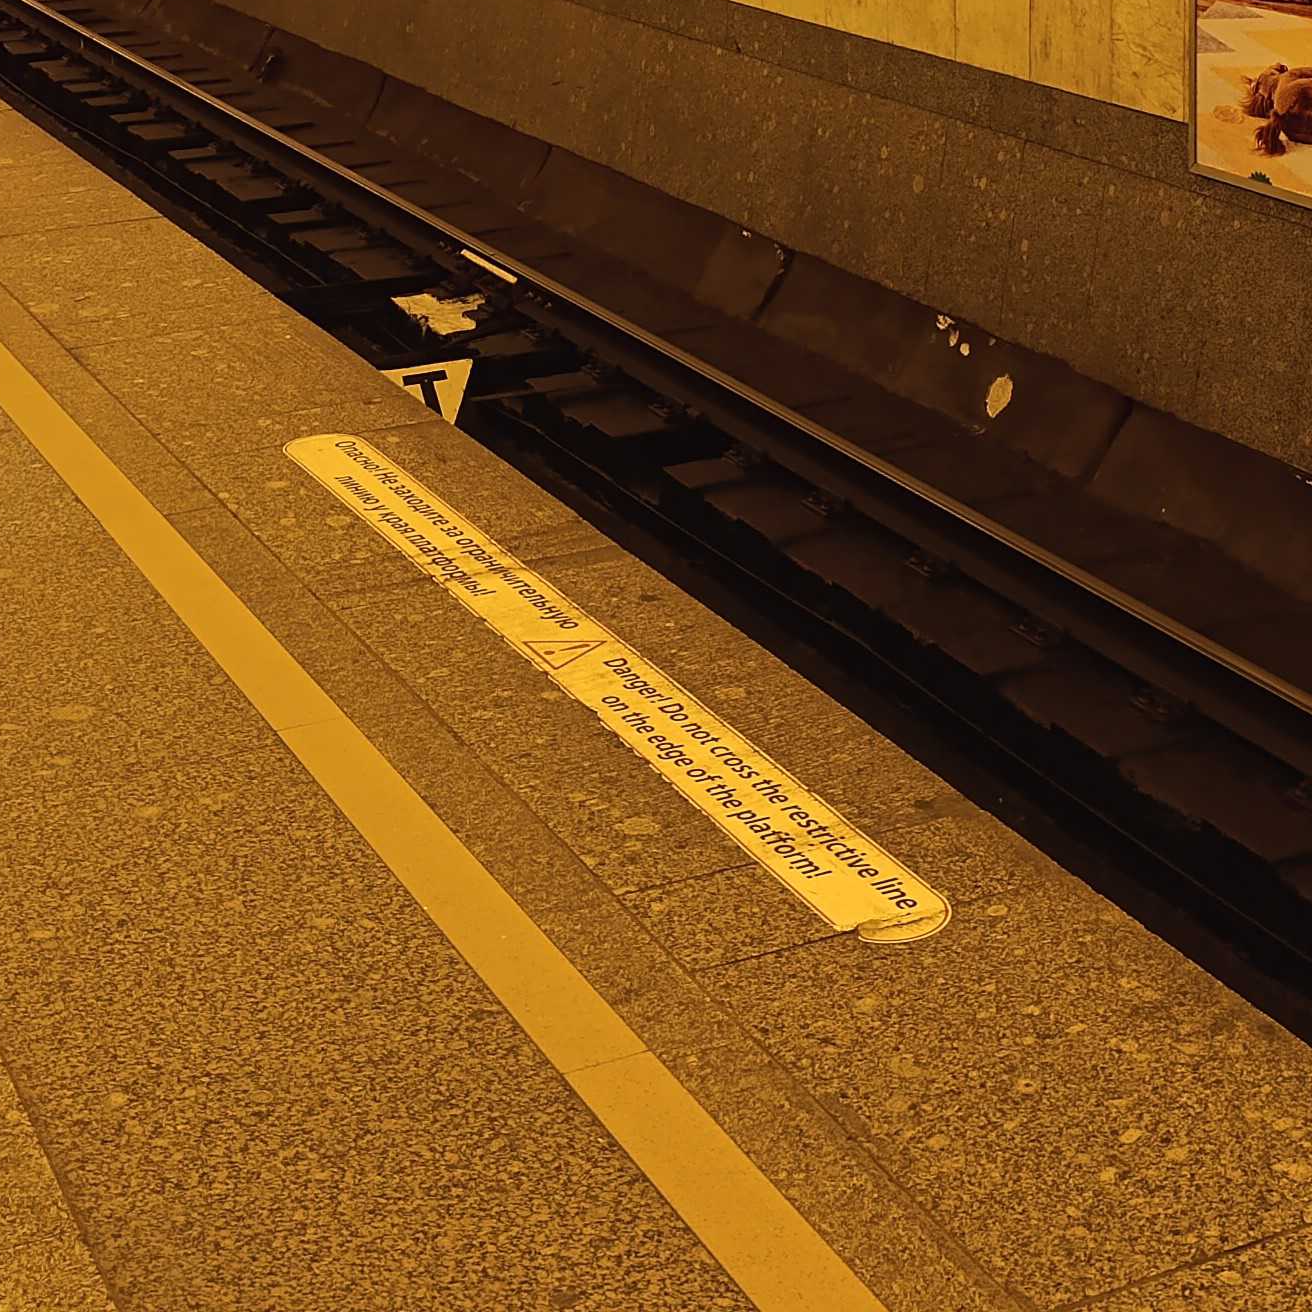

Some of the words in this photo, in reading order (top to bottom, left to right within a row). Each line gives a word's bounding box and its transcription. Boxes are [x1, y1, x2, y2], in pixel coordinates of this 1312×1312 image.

[335, 440, 382, 480] Опасно!
[379, 472, 398, 486] Не
[392, 481, 449, 527] заходите
[441, 520, 461, 539] за
[456, 537, 579, 631] ограничительную
[335, 475, 380, 506] линию
[371, 504, 386, 519] у
[379, 510, 414, 540] края
[405, 535, 497, 598] платформы!
[601, 694, 629, 713] on
[621, 710, 656, 734] the
[647, 733, 694, 768] edge
[687, 768, 722, 786] of
[706, 784, 743, 810] the
[727, 806, 832, 880] platform!
[603, 657, 673, 706] Danger!
[658, 702, 689, 723] Do
[683, 720, 722, 747] not
[710, 744, 760, 781] cross
[752, 777, 788, 805] the
[781, 802, 879, 880] restrictive
[871, 875, 918, 911] line
